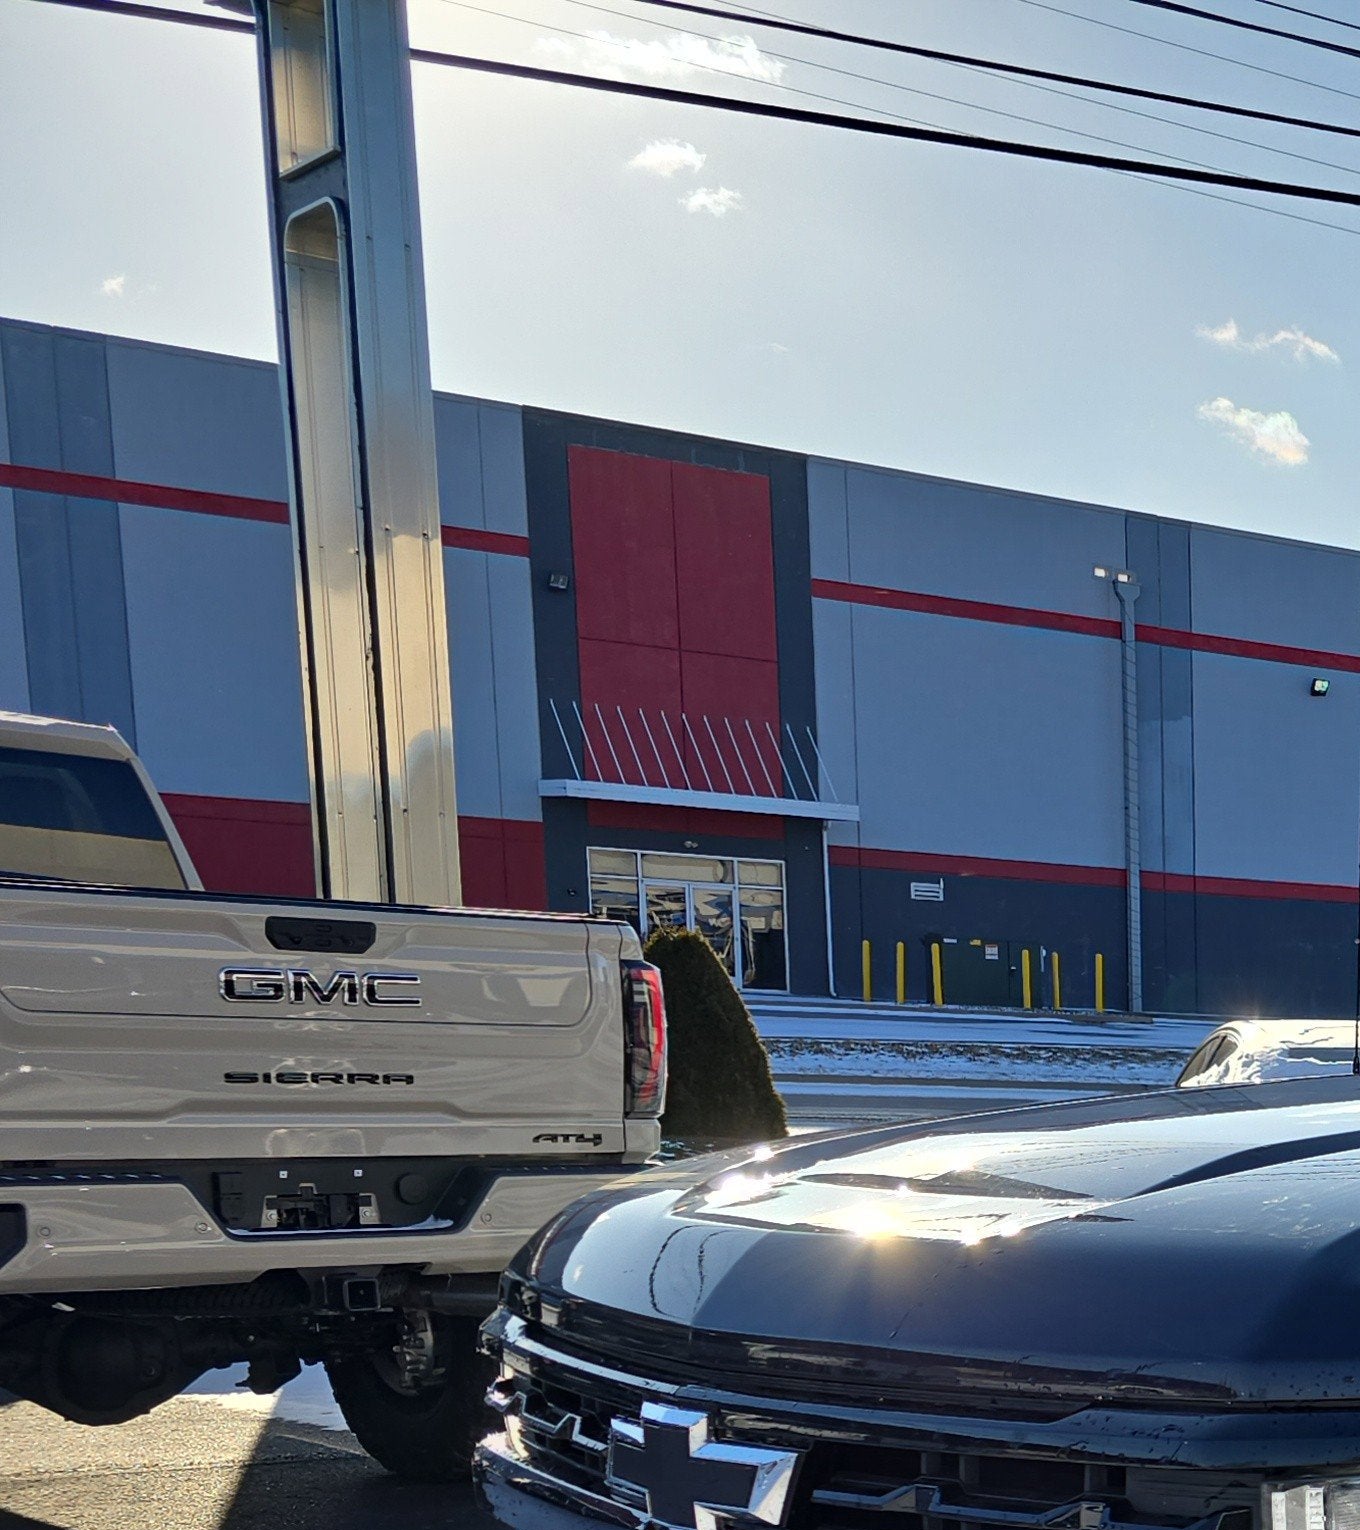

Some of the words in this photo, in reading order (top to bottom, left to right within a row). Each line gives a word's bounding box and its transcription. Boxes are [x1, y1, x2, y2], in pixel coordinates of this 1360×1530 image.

[219, 966, 422, 1007] GMC
[223, 1071, 414, 1085] SIERRA
[532, 1133, 602, 1147] AT4
